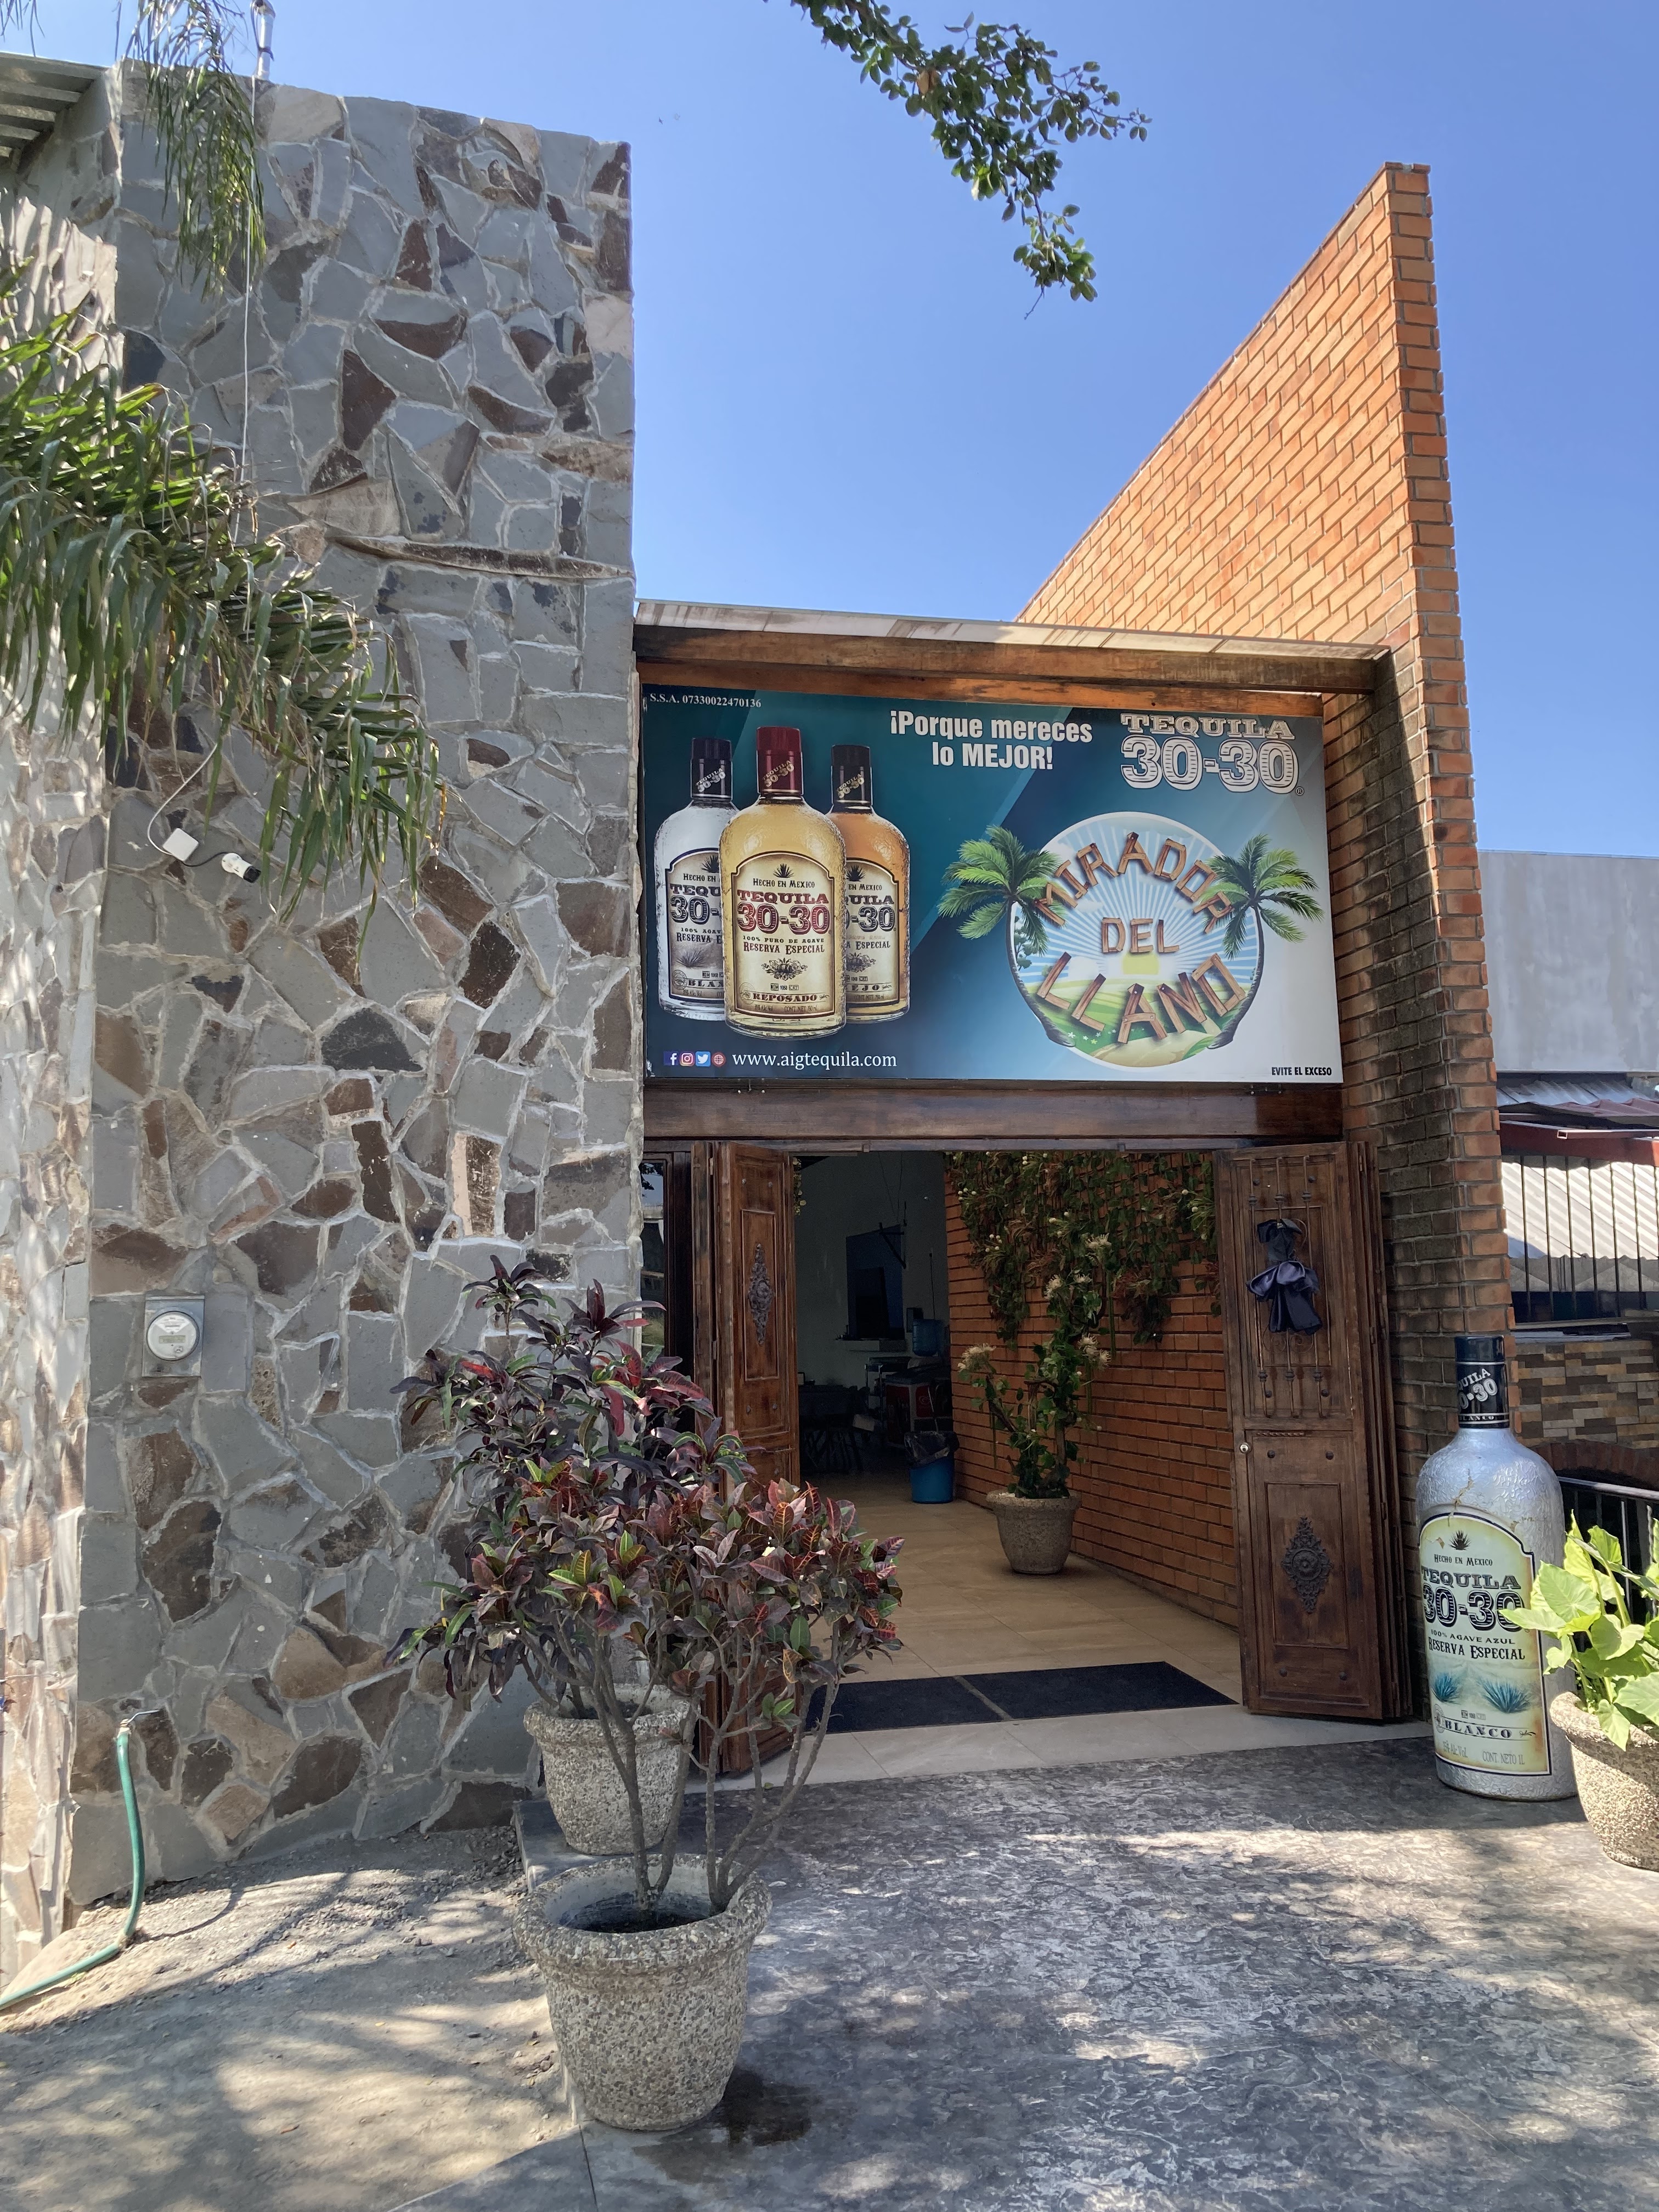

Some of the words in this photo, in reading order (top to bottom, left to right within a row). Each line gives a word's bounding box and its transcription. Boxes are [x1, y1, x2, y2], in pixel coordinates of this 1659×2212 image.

[650, 693, 680, 703] S.S.A.
[682, 695, 761, 708] 07330022470136
[890, 710, 983, 740] ¡Porque
[991, 719, 1093, 743] mereces
[1120, 713, 1295, 740] TEQUILA
[932, 742, 955, 766] lo
[962, 743, 1053, 770] MEJOR!
[1121, 734, 1299, 794] 30-30
[695, 768, 723, 786] TEQUILA
[762, 760, 791, 780] TEQUILA
[764, 763, 794, 787] 30-30
[697, 771, 726, 793] 30-30
[836, 774, 862, 792] TEQUILA
[838, 777, 865, 799] 30-30
[683, 873, 706, 881] HECHO
[753, 878, 775, 887] HECHO
[788, 880, 815, 888] MEXICO
[1035, 832, 1234, 934] MIRADOR
[737, 889, 829, 905] TEQUILA
[670, 894, 722, 925] 30-
[737, 901, 830, 934] 30-30
[676, 932, 712, 943] RESERVA
[1101, 917, 1180, 953] DEL
[743, 941, 780, 953] RESERVA
[785, 944, 825, 955] ESPECIAL
[855, 940, 891, 950] ESPECIAL
[752, 992, 817, 1002] REPOSADO
[1037, 952, 1246, 1044] LLANO
[732, 1051, 898, 1070] www.aigtequila.com
[1272, 1066, 1292, 1076] EVITE
[1294, 1066, 1303, 1075] EL
[1305, 1066, 1332, 1076] EXCESO
[1434, 1554, 1452, 1564] HECHO
[1466, 1557, 1493, 1566] MEXICO
[1421, 1565, 1521, 1589] TEQUILA
[1423, 1582, 1526, 1633] 30-30
[1431, 1629, 1447, 1638] 100%
[1449, 1633, 1483, 1643] AGAVE
[1428, 1637, 1465, 1656] RESERVA
[1470, 1645, 1526, 1660] ESPECIAL
[1444, 1720, 1513, 1739] BLANCO
[1500, 1752, 1517, 1764] NETO
